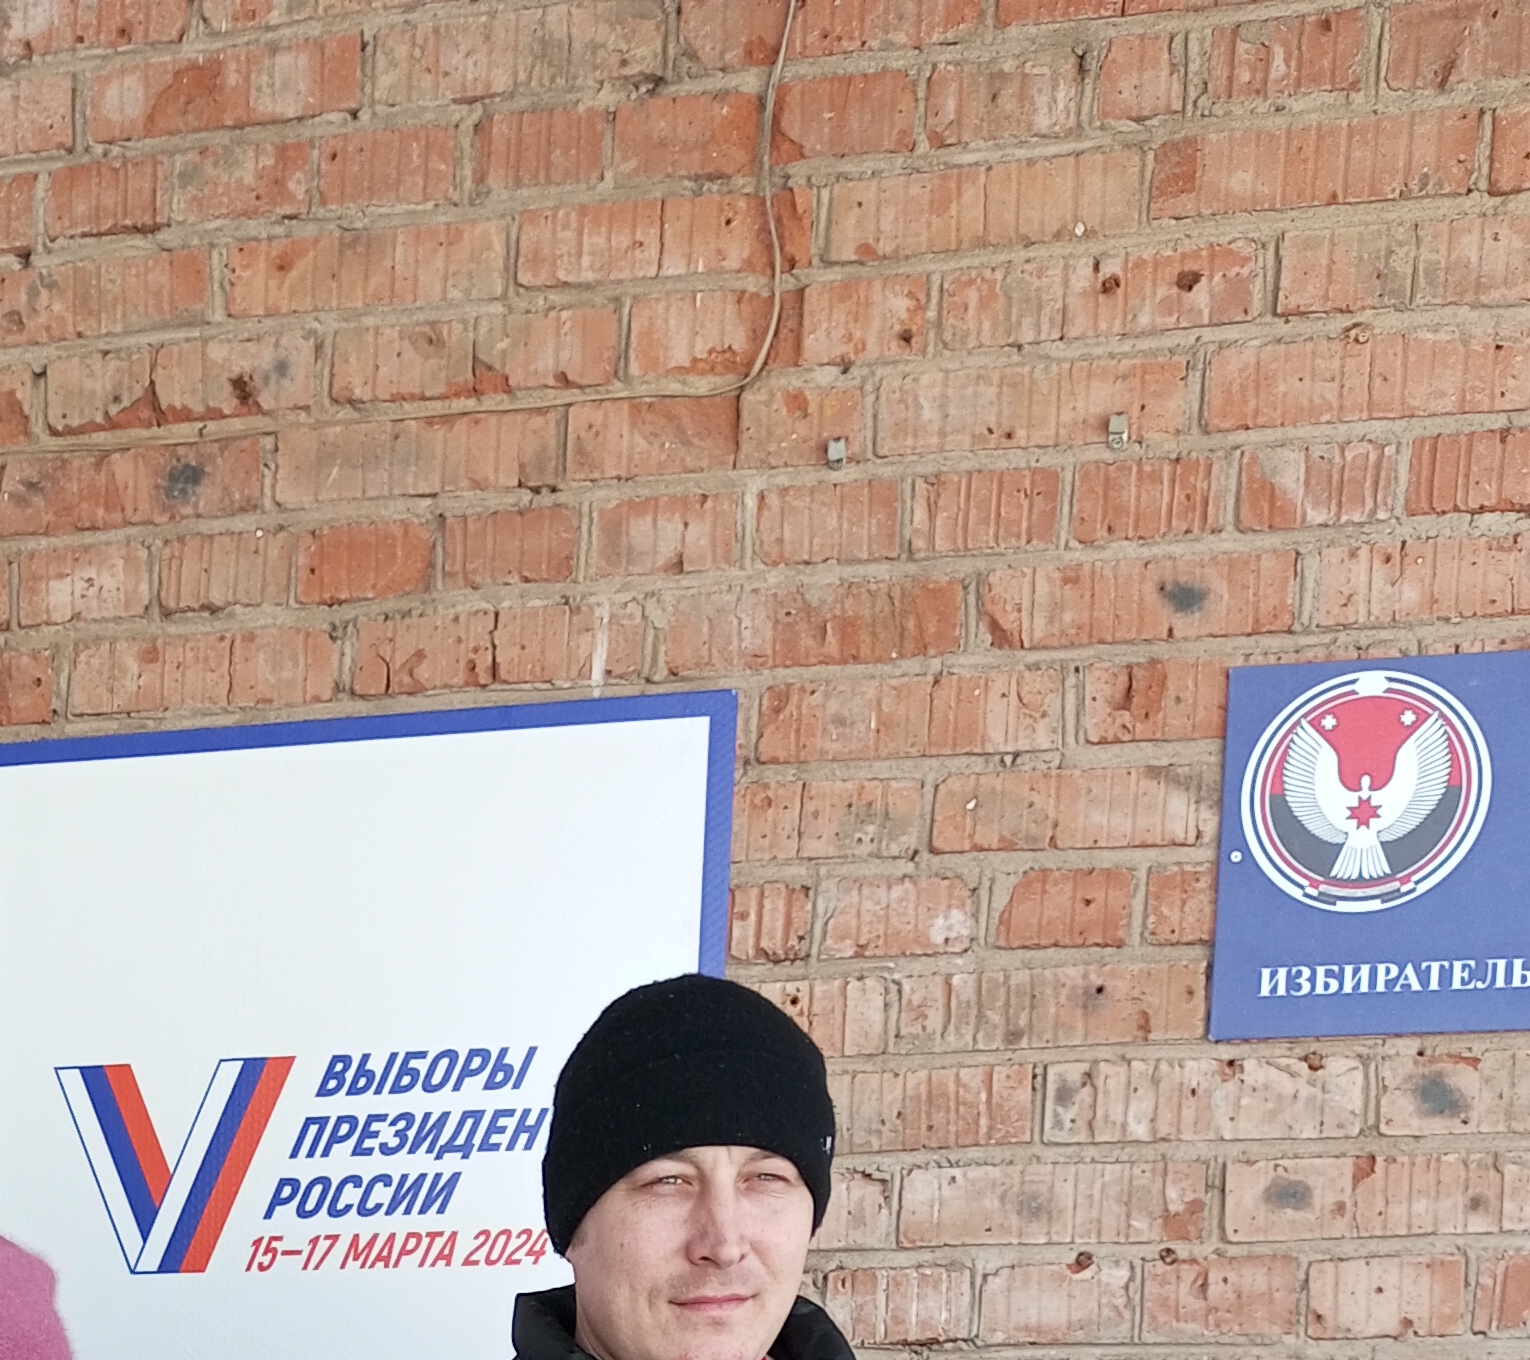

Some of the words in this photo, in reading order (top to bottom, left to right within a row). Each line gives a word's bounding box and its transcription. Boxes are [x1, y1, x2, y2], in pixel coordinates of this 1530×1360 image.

[1257, 958, 1530, 997] ИЗБИРАТЕЛЬ
[315, 1046, 538, 1098] ВЫБОРЫ
[289, 1107, 550, 1160] ПРЕЗИДЕН
[263, 1172, 462, 1220] РОССИИ
[341, 1230, 458, 1271] МАРТА
[463, 1228, 549, 1268] 2024
